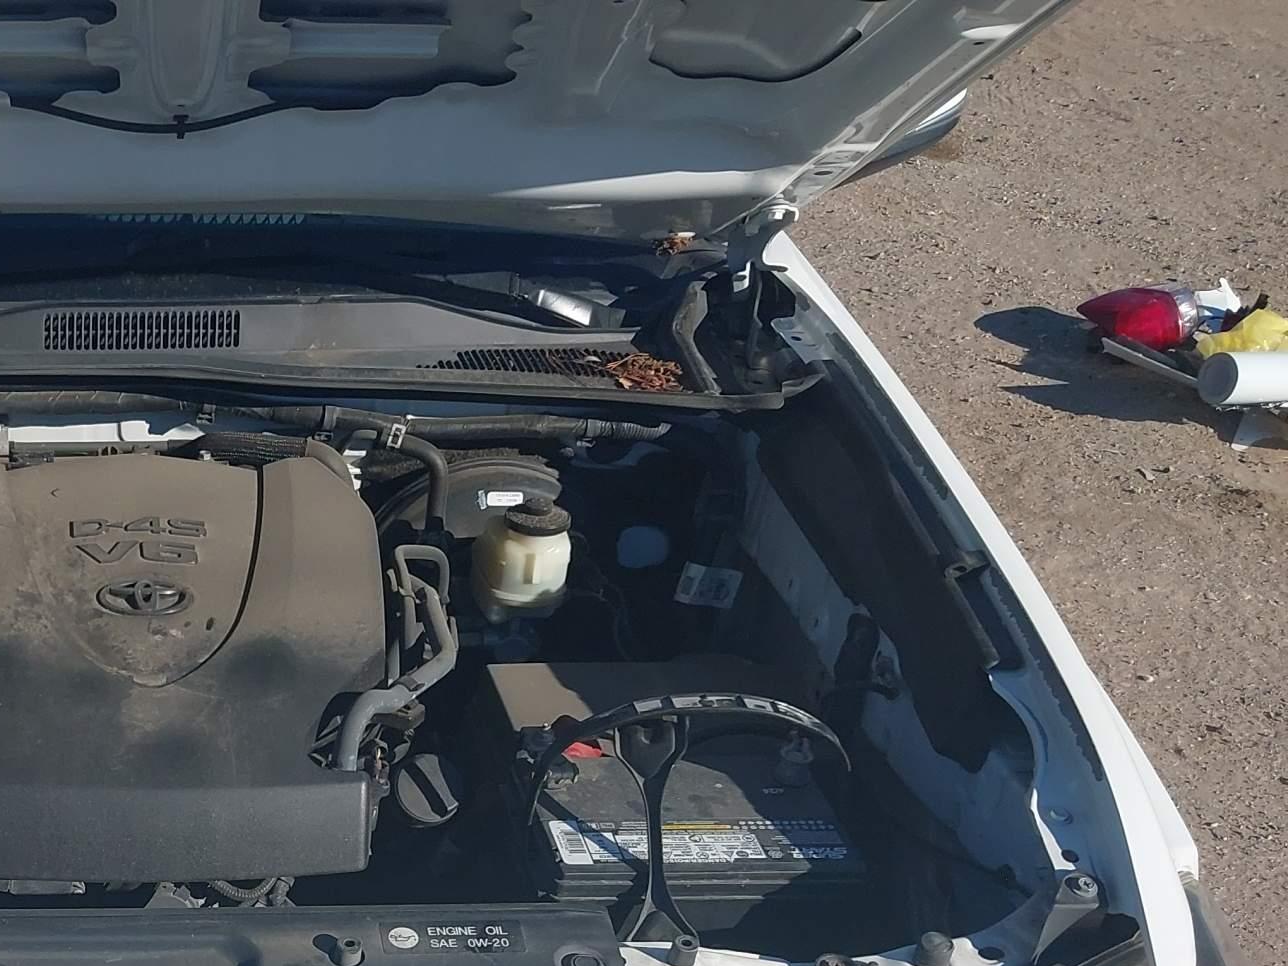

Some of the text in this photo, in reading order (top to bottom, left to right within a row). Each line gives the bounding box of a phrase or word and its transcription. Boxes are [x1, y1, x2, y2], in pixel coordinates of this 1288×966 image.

[69, 516, 208, 539] D-4S
[74, 541, 200, 566] V6
[427, 926, 509, 936] ENGINE OIL
[430, 938, 510, 948] SAE 0W-20
